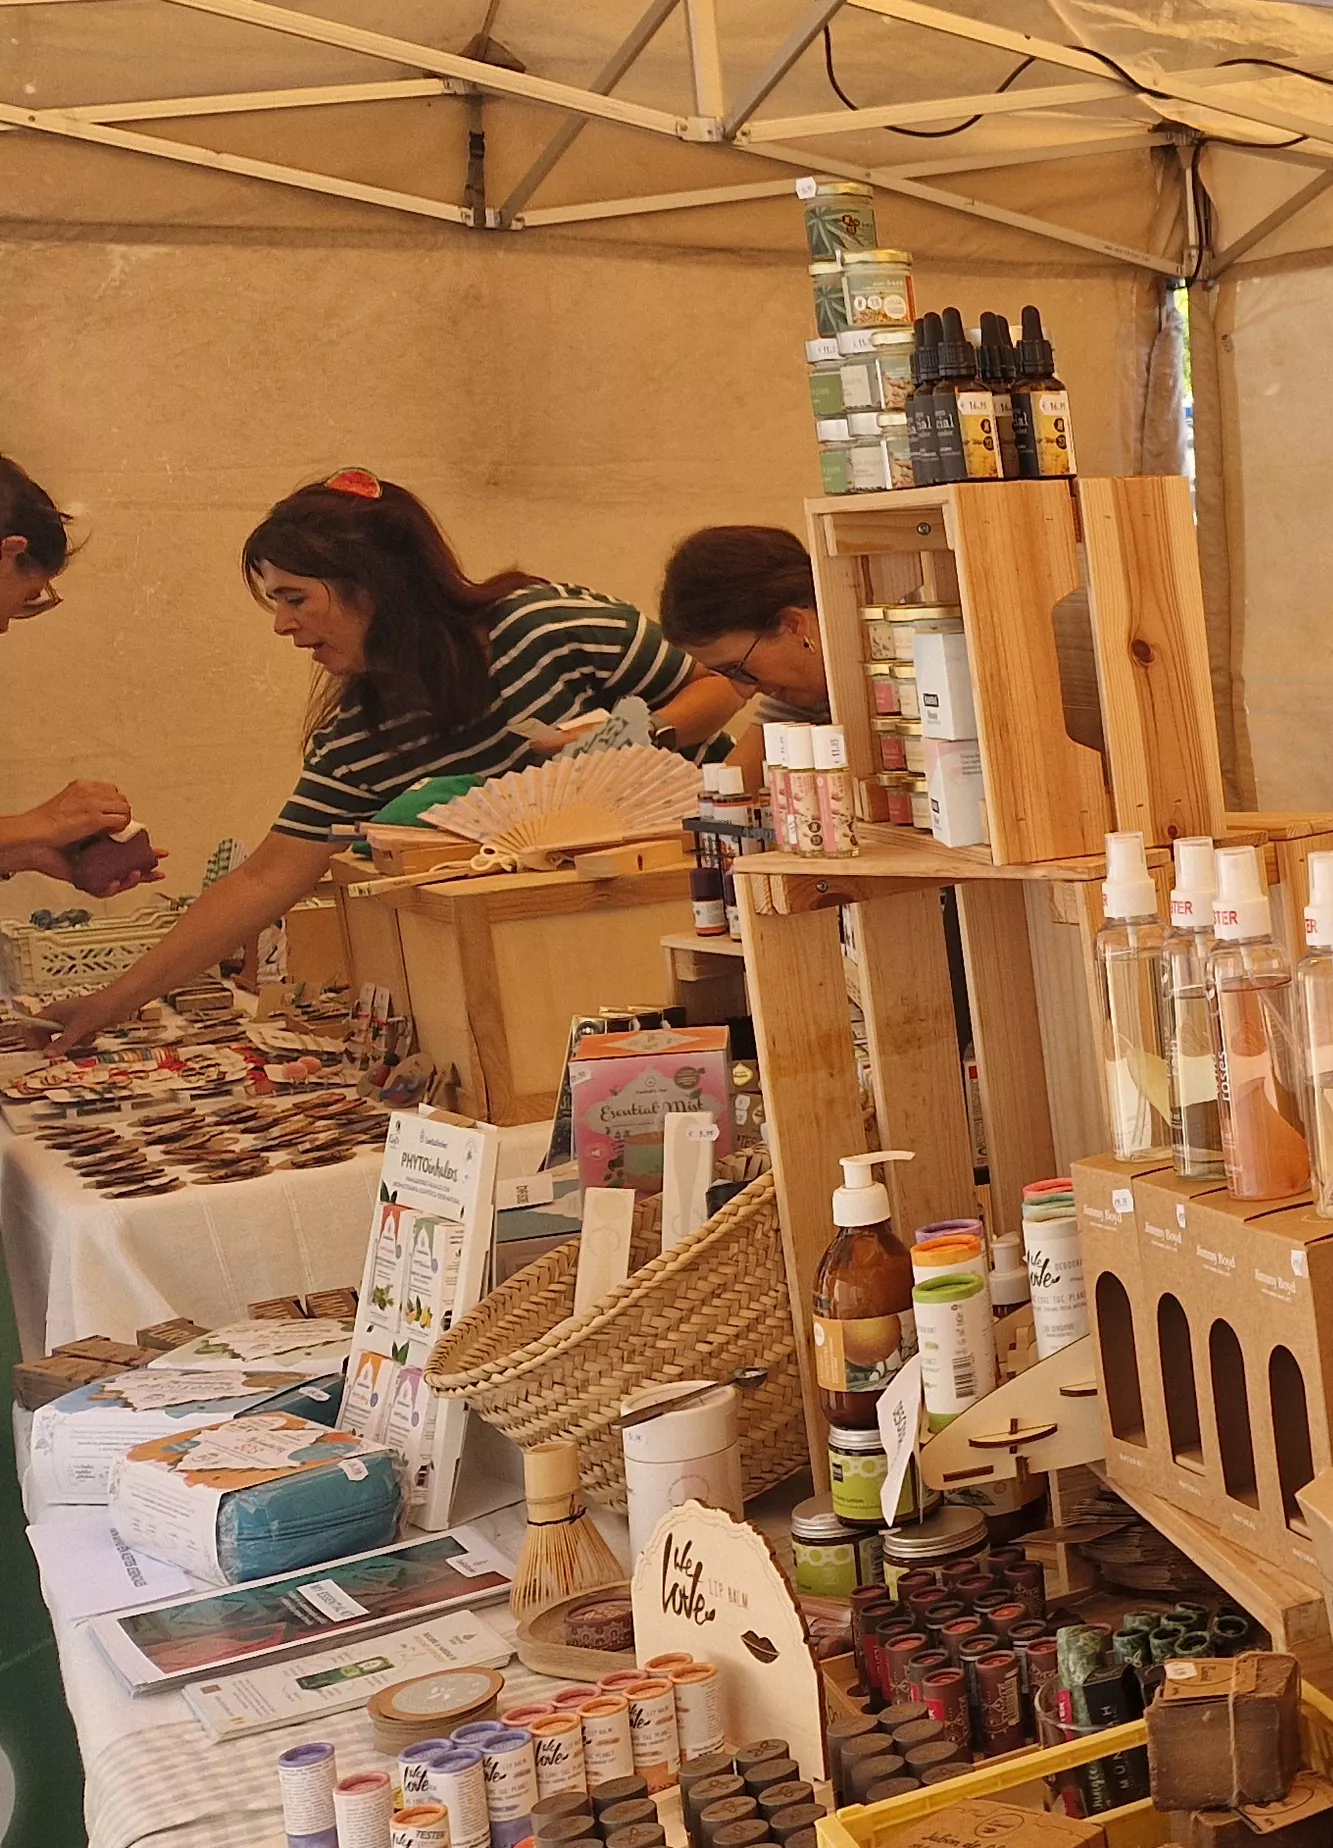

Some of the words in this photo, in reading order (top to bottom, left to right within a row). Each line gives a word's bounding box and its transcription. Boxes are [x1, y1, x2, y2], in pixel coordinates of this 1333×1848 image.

[708, 1578, 724, 1598] LIP
[727, 1586, 750, 1610] BALM
[415, 1830, 446, 1840] TESTER
